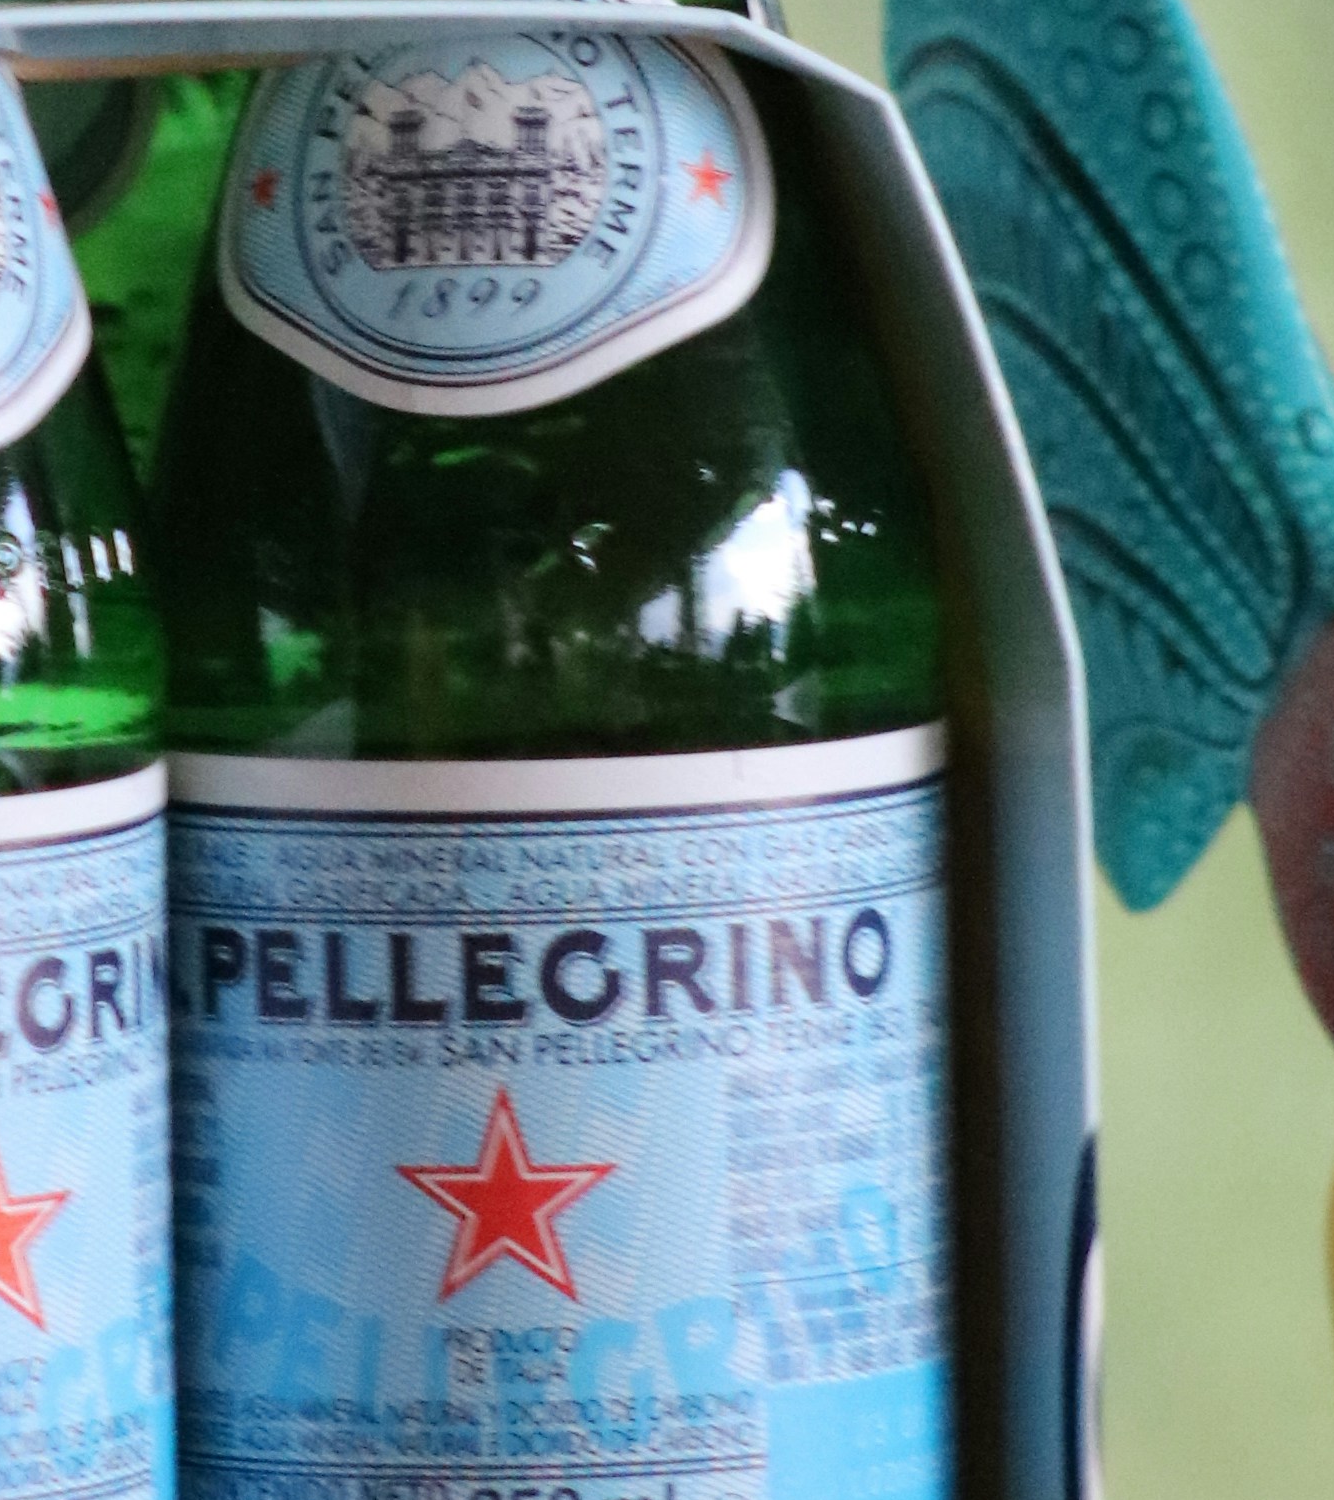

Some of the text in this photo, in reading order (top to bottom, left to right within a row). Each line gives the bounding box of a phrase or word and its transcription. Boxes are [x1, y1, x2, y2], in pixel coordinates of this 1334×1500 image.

[585, 84, 645, 270] TERME
[310, 171, 353, 276] SAN
[389, 277, 543, 320] 1899
[439, 1033, 521, 1068] SAN
